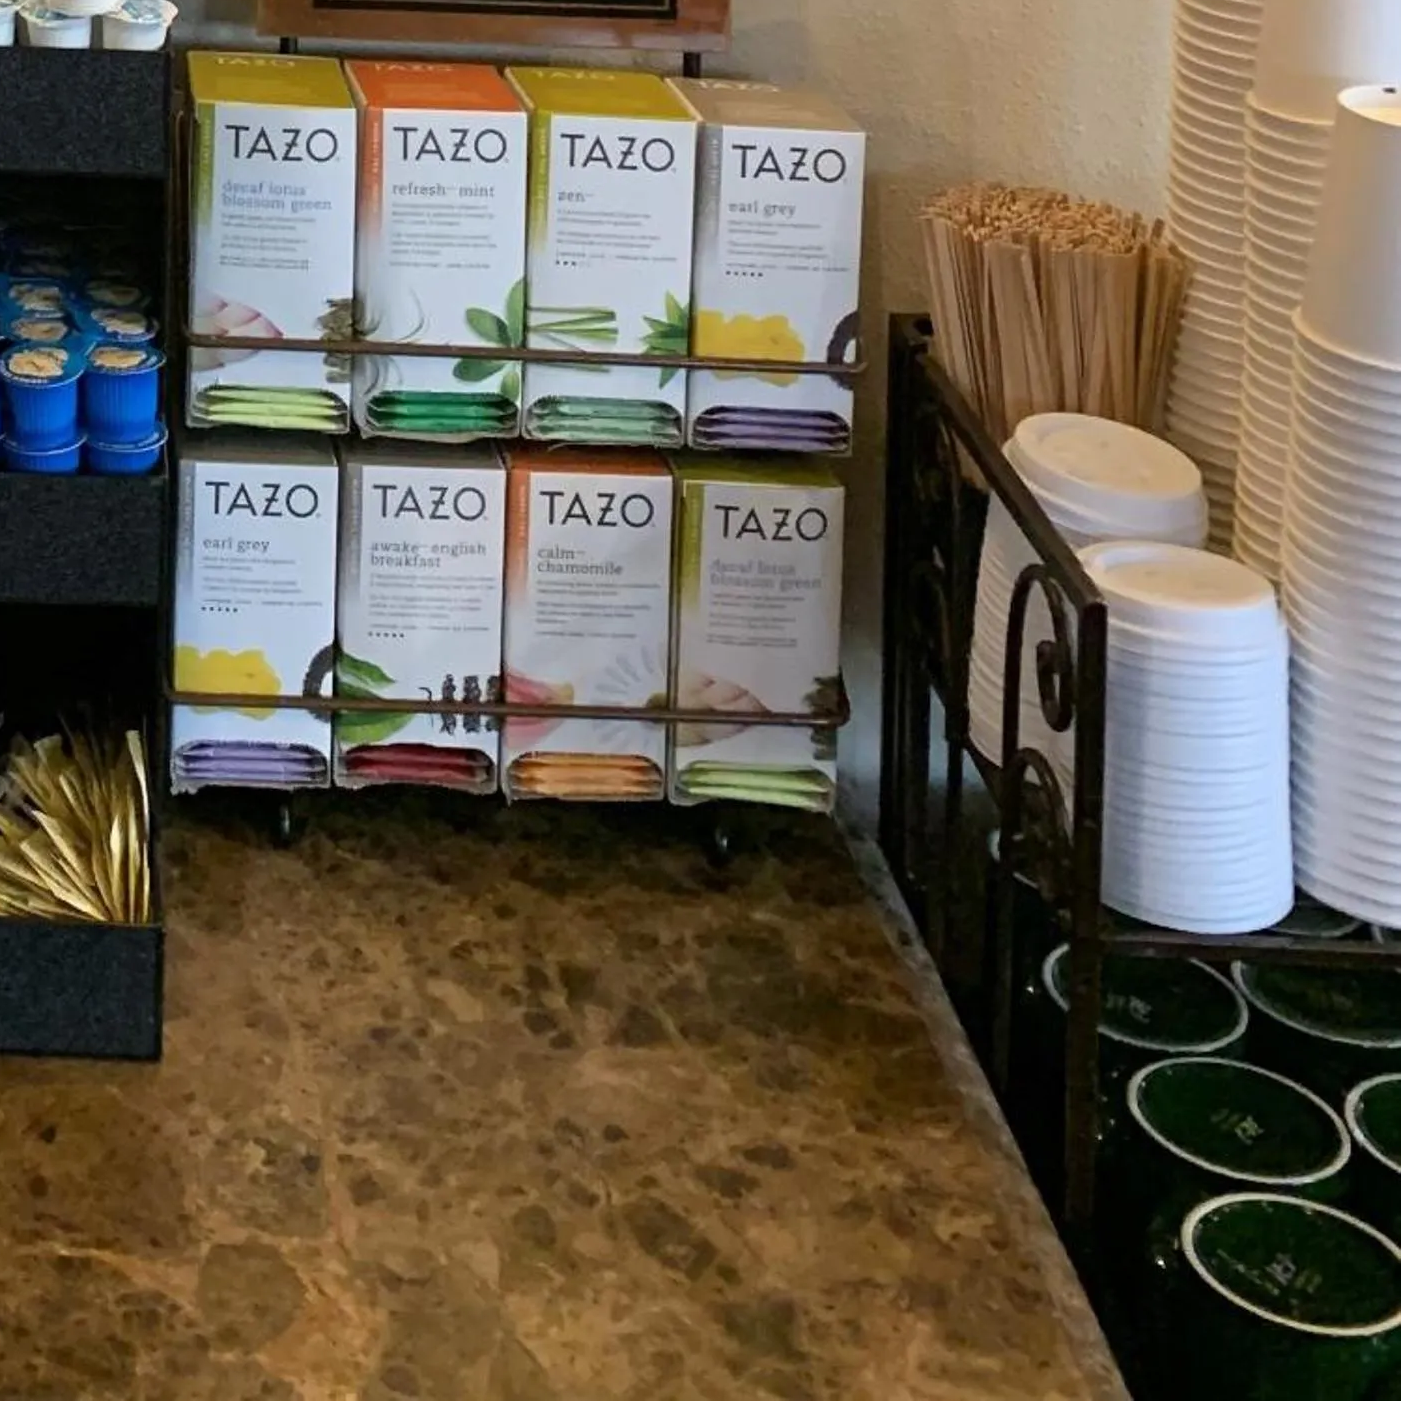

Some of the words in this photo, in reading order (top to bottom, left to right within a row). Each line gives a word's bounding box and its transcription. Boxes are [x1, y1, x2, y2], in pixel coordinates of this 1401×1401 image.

[225, 125, 338, 163] TAZO
[393, 127, 507, 164] TAZO
[560, 133, 675, 172] TAZO
[732, 144, 847, 183] TAZO
[459, 184, 495, 197] mint
[204, 481, 319, 518] TAZO
[372, 484, 487, 521] TAZO
[539, 491, 655, 528] TAZO
[714, 504, 829, 541] TAZO
[237, 540, 270, 553] grey
